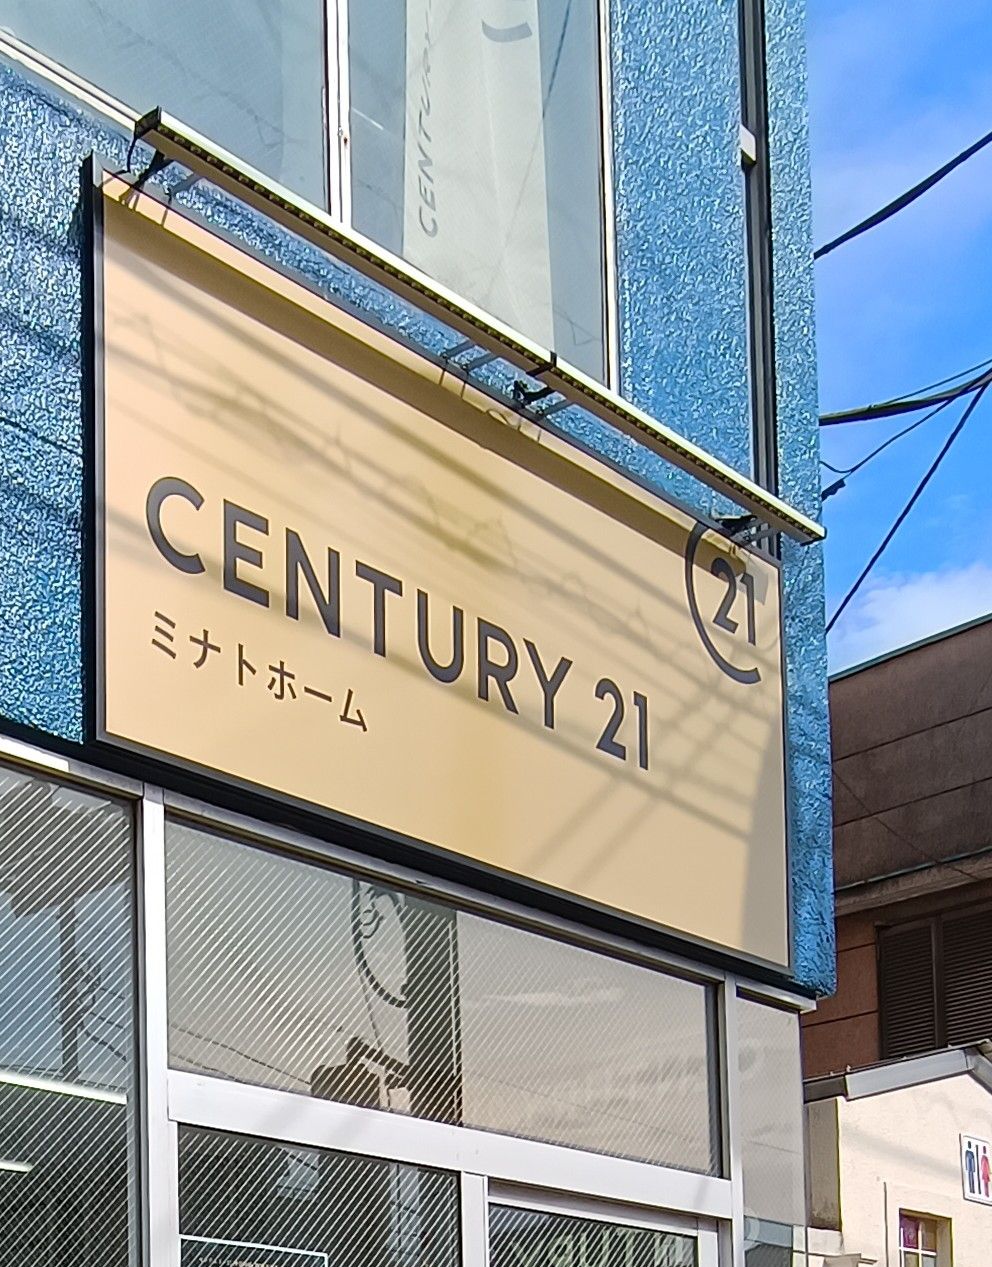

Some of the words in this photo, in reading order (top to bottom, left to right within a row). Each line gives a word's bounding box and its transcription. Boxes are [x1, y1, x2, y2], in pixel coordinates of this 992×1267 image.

[145, 476, 572, 730] CENTURY
[594, 677, 649, 771] 21
[710, 556, 757, 646] 21
[151, 610, 369, 733] ミナトホーム
